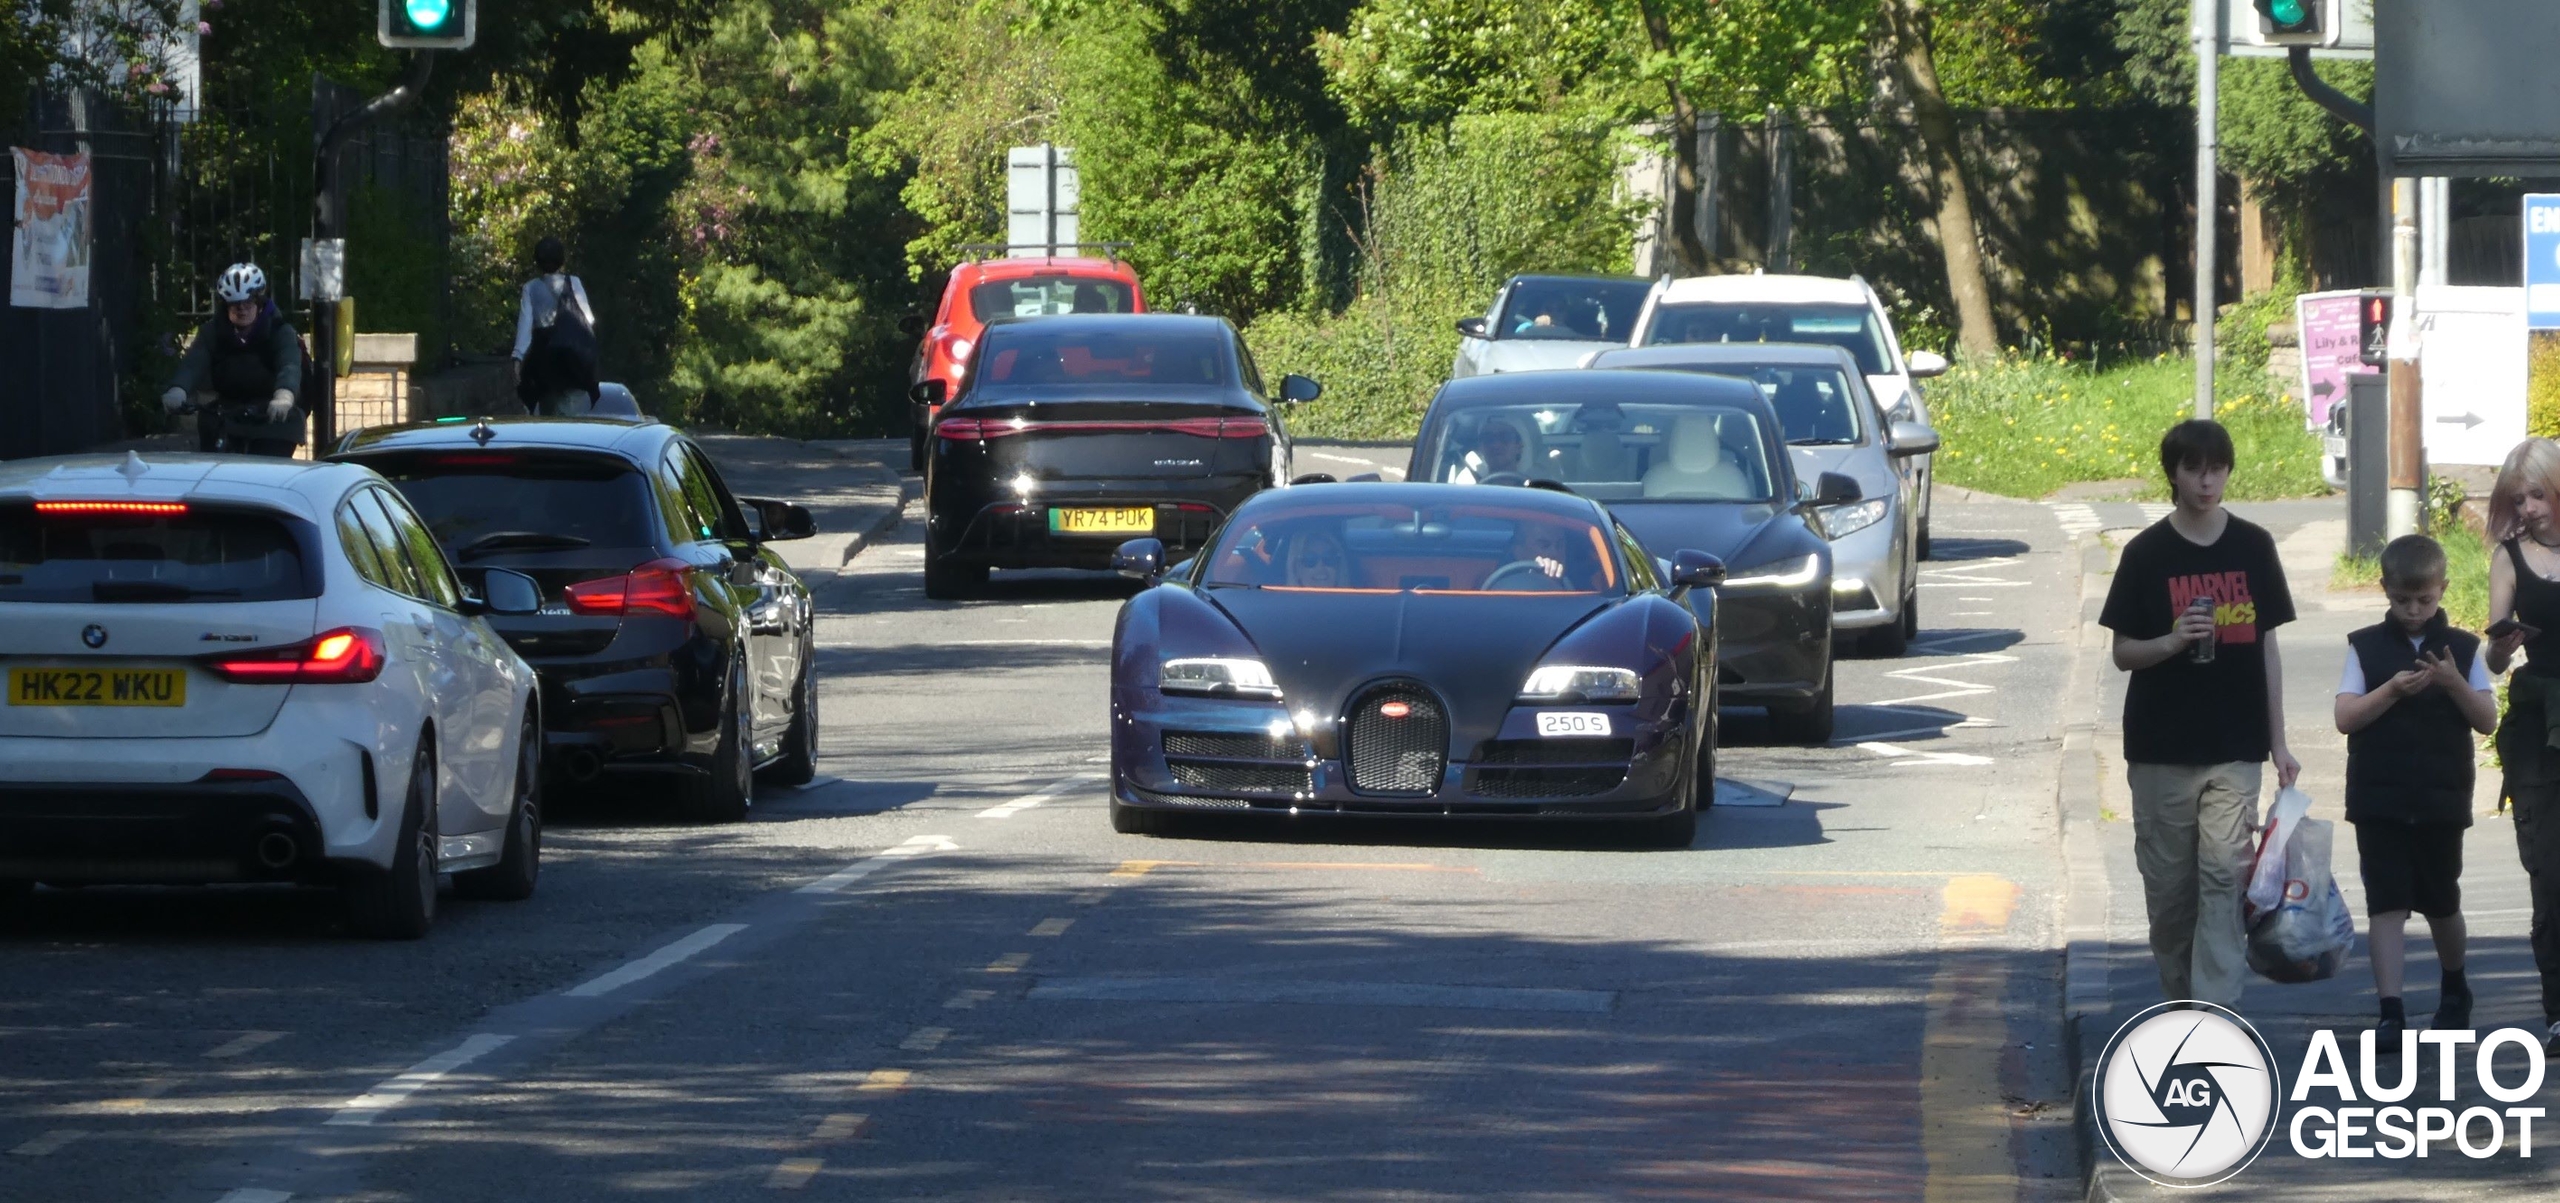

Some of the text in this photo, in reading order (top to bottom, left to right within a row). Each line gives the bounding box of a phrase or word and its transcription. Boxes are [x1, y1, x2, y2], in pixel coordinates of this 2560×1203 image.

[2315, 337, 2336, 350] Lily
[2339, 336, 2348, 347] &
[2336, 353, 2361, 365] Caf
[1063, 510, 1148, 527] YR74 PUK
[2168, 571, 2253, 620] MARVEL
[535, 608, 571, 616] 140i
[22, 672, 173, 701] HK22 WKU
[1544, 715, 1604, 732] 250 S
